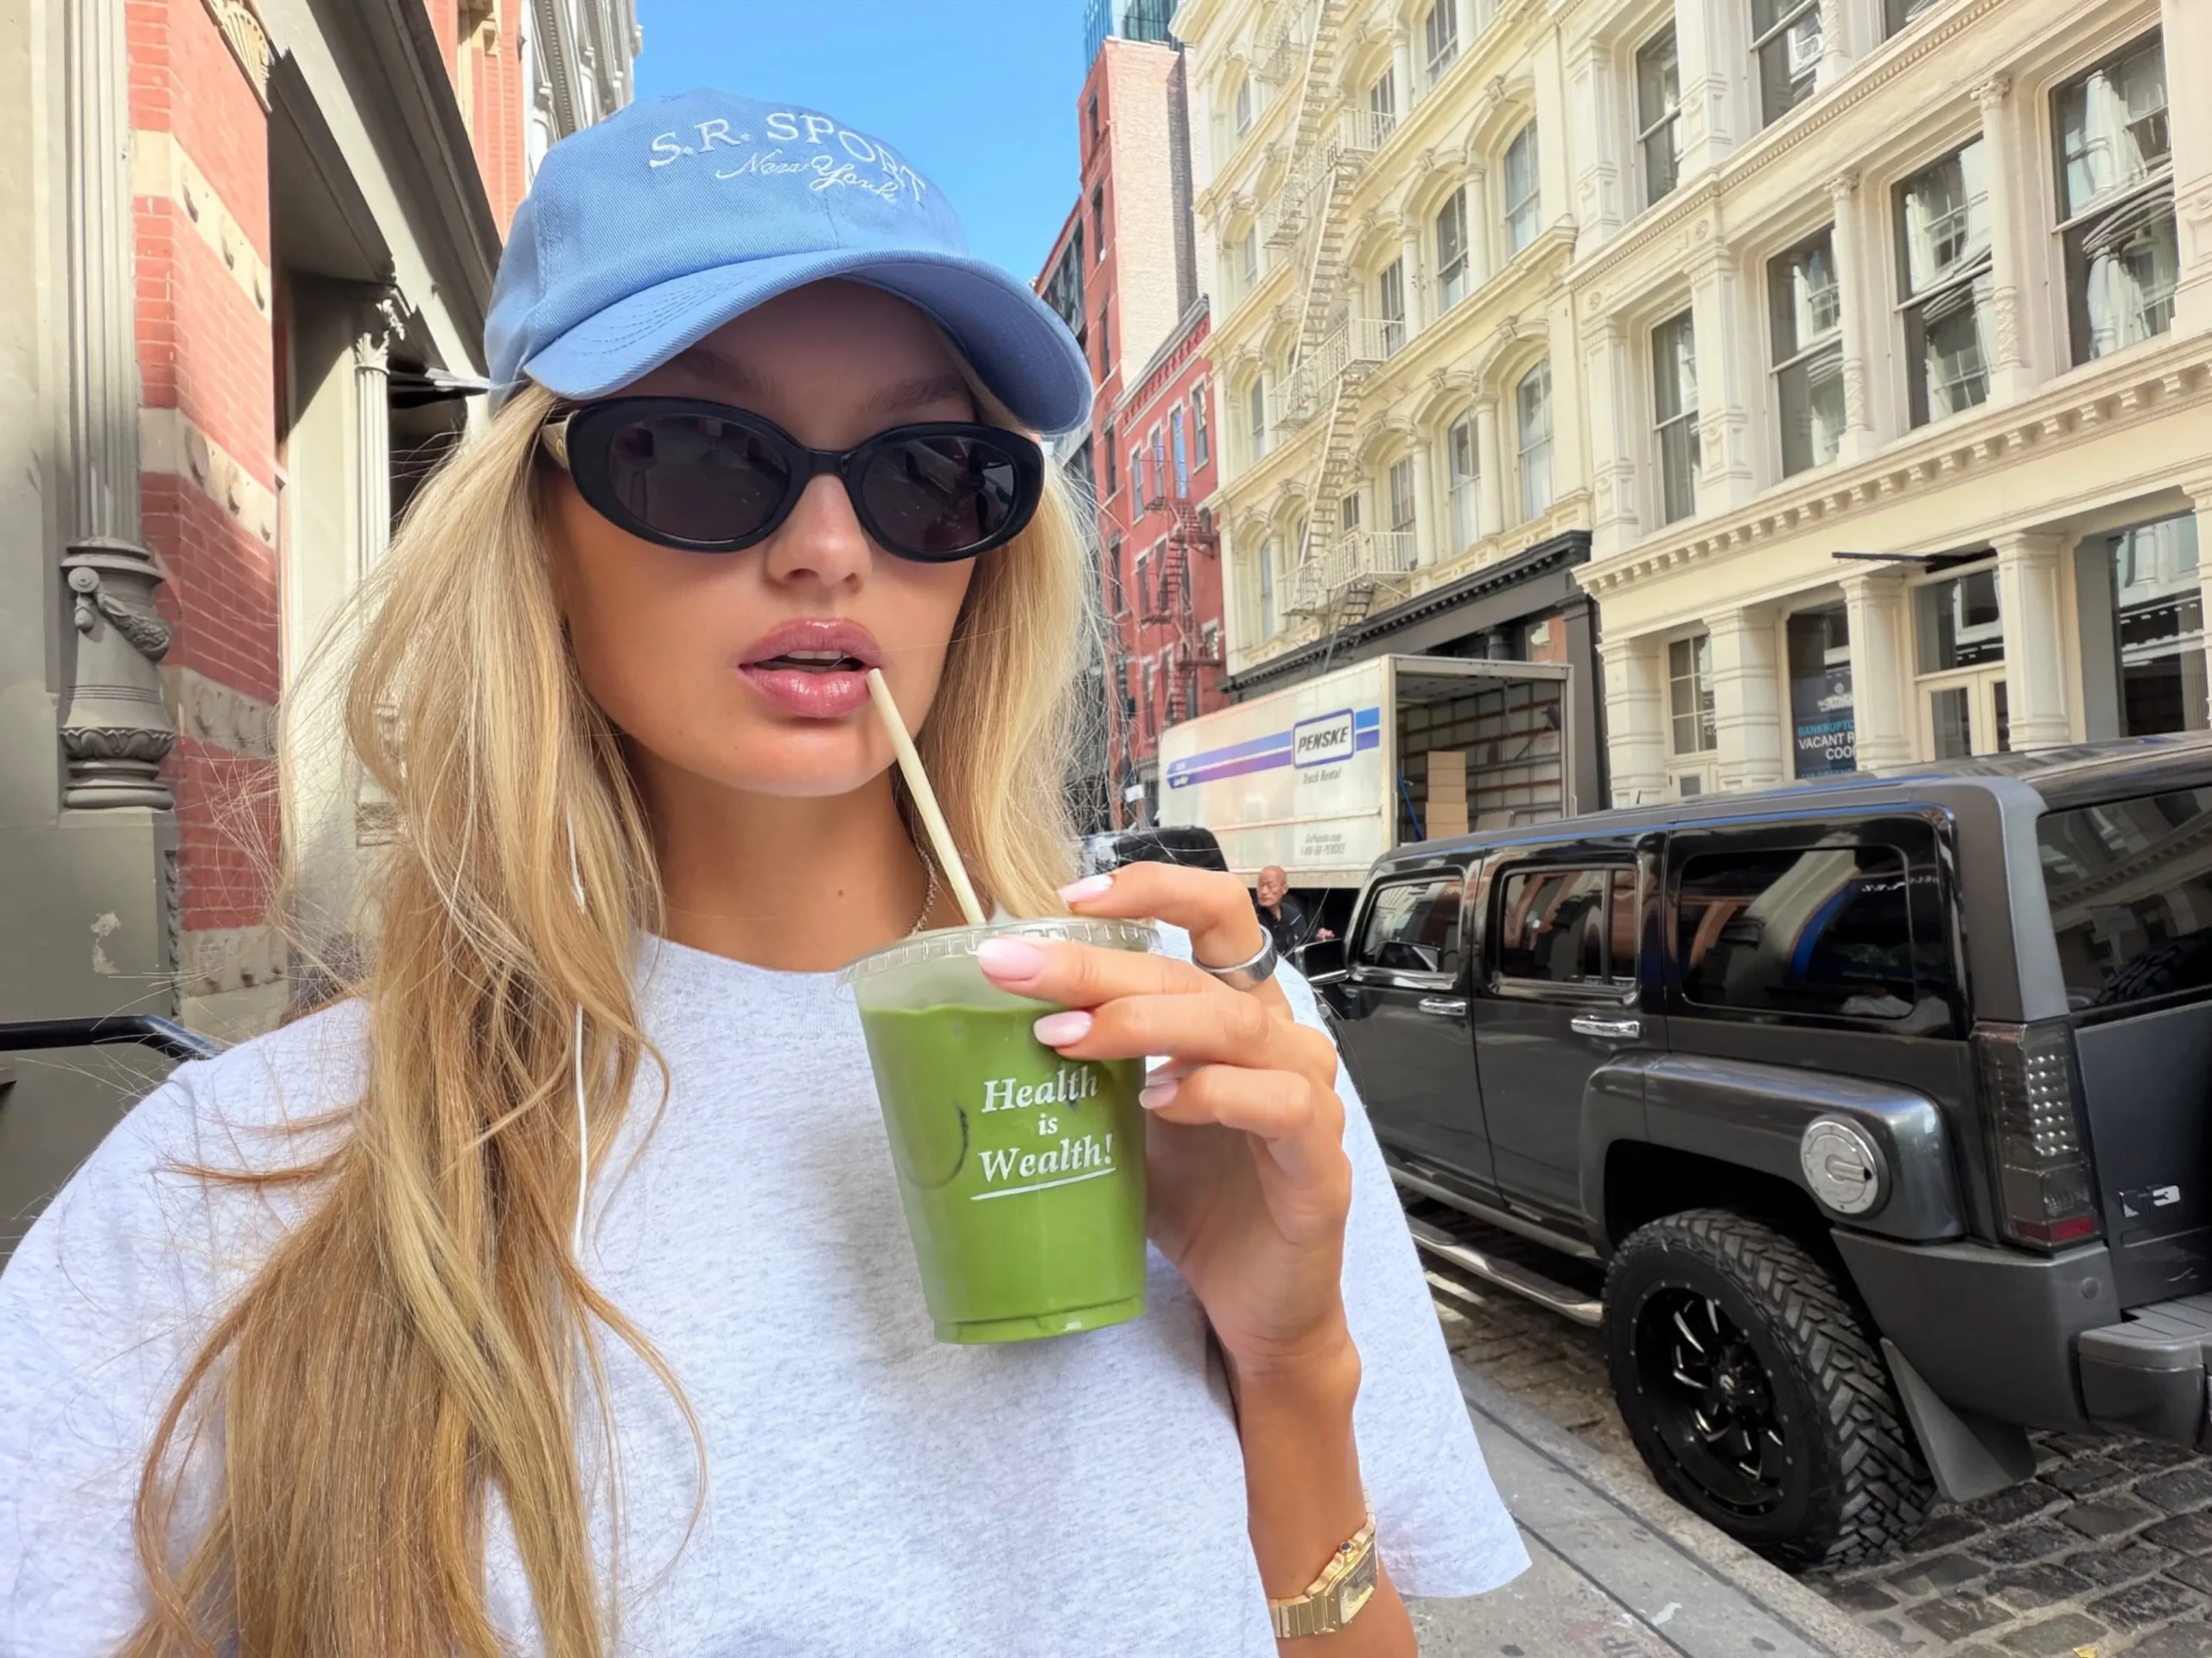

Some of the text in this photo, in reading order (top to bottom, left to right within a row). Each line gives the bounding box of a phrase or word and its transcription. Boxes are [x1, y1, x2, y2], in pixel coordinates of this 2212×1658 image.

[766, 112, 928, 201] SPORT
[809, 155, 902, 202] York
[1298, 726, 1349, 753] PENSKE
[1798, 733, 1845, 750] VACANT
[1826, 746, 1856, 760] COO
[982, 1065, 1098, 1113] Health
[1039, 1113, 1058, 1135] is
[978, 1133, 1113, 1182] Wealth!
